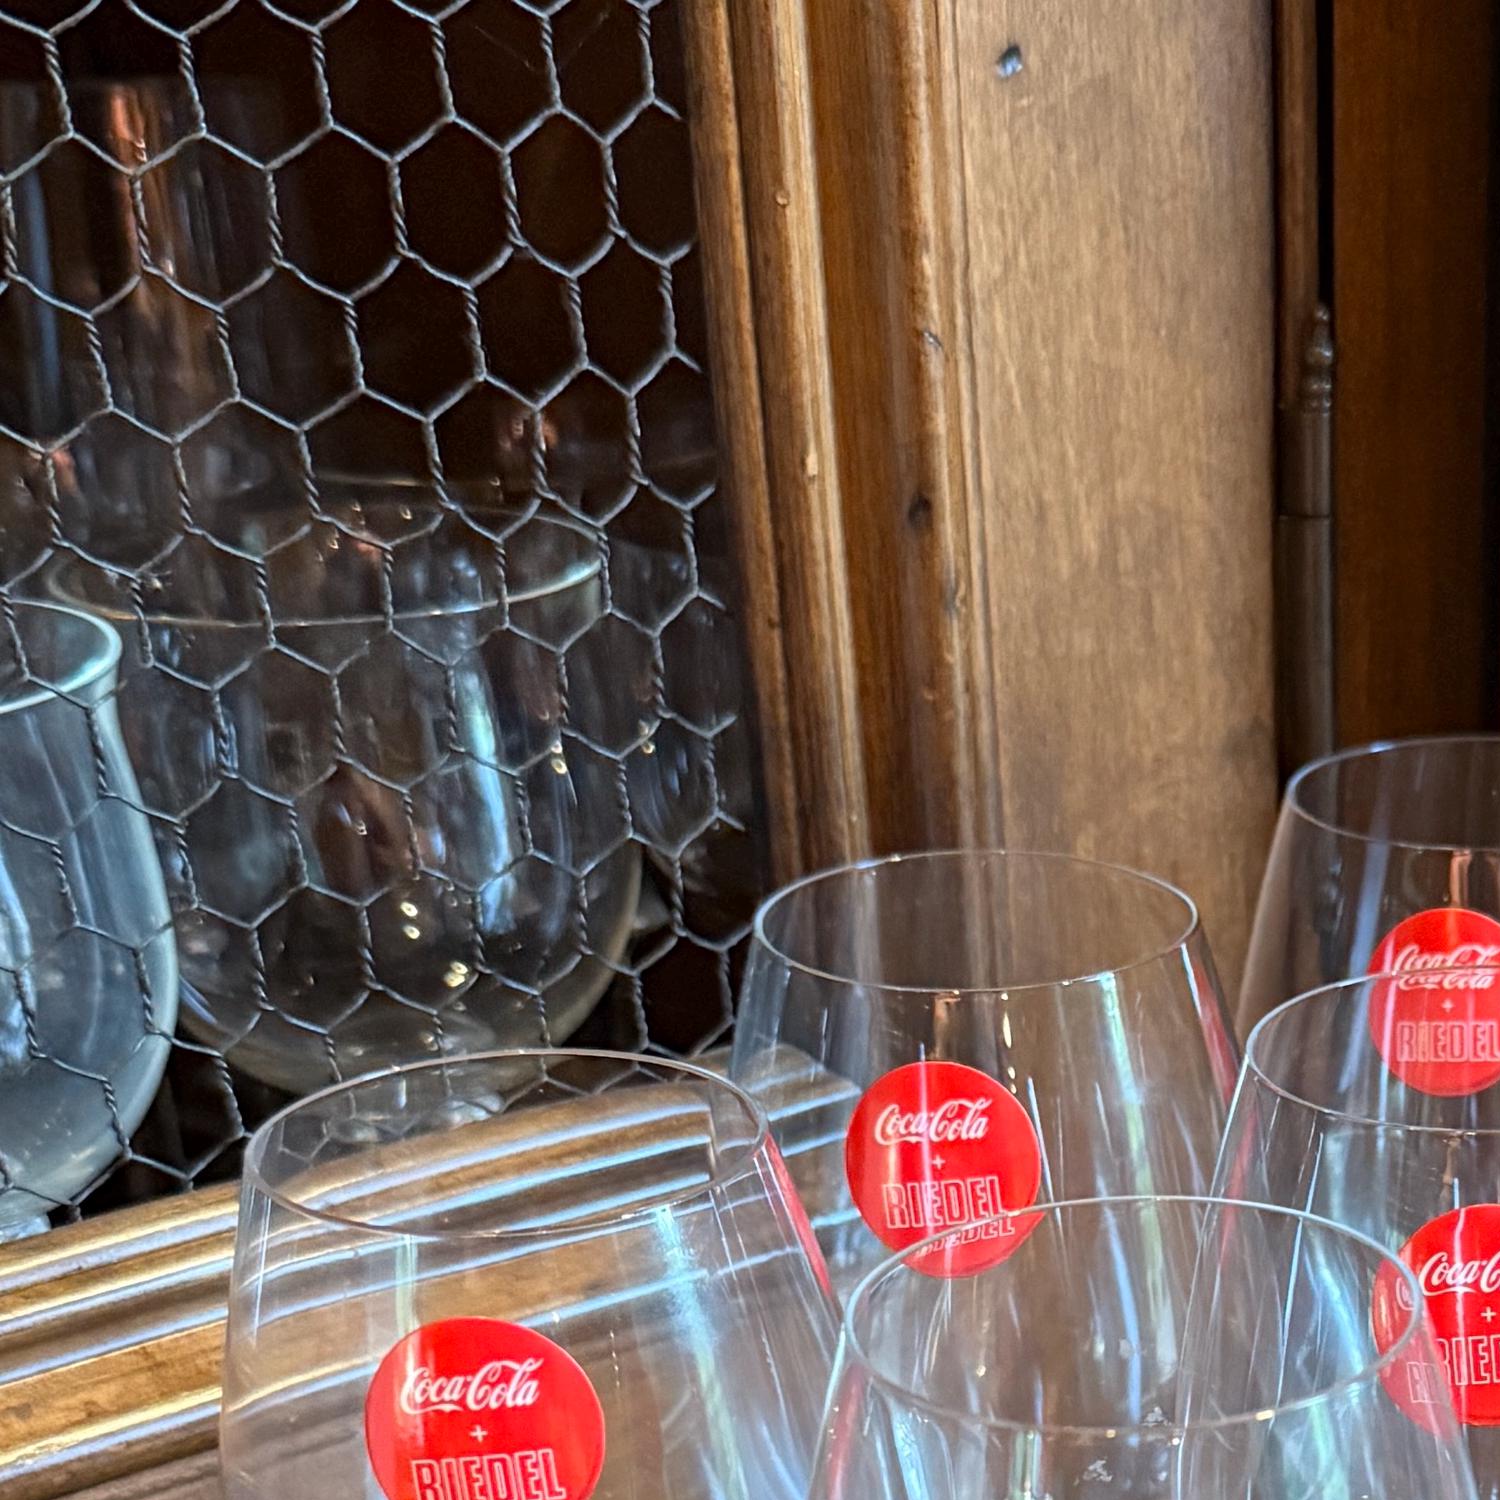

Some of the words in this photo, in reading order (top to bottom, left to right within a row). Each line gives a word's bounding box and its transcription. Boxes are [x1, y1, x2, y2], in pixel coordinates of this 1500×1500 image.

[875, 1098, 992, 1146] Coca-Cola
[882, 1175, 1010, 1229] RIEDEL
[400, 1358, 544, 1415] Coca-Cola
